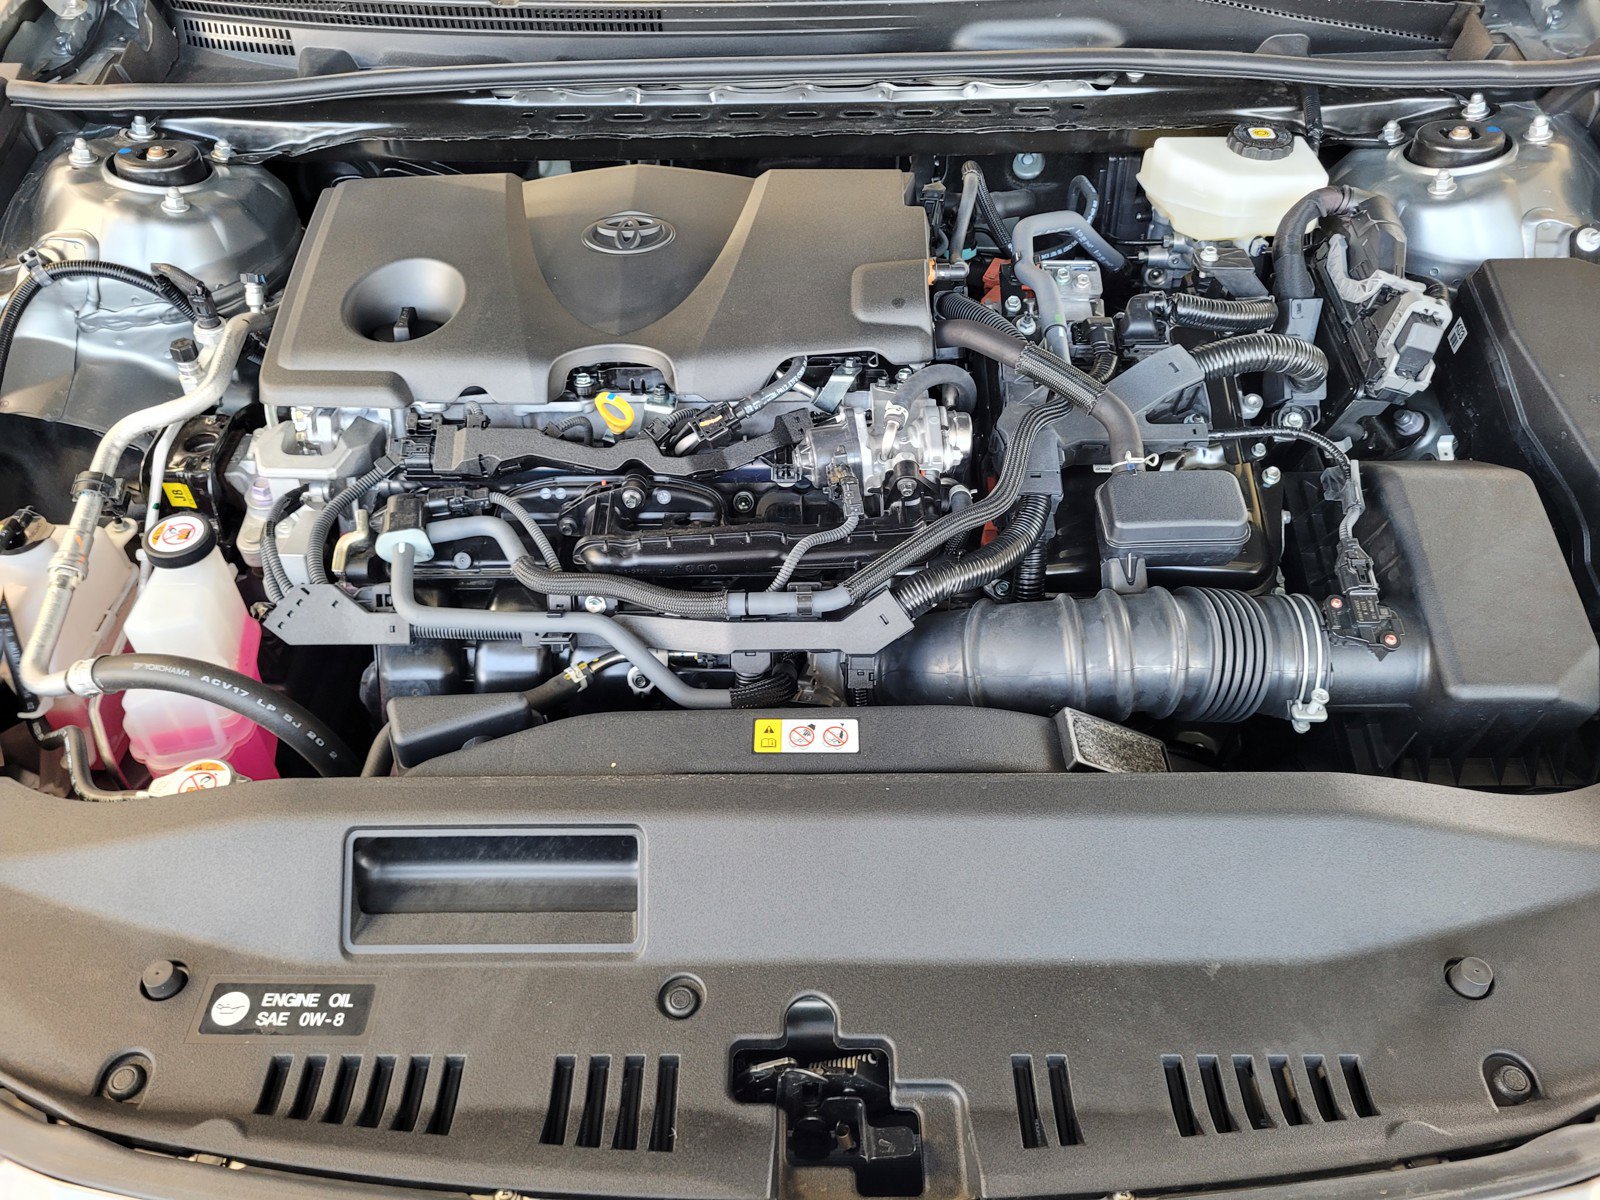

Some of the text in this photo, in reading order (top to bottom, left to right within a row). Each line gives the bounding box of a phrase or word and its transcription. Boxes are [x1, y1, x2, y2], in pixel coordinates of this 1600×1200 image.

[144, 663, 191, 677] YOKOHAMA
[200, 675, 250, 698] ACV17
[256, 698, 276, 712] LP
[261, 993, 354, 1008] ENGINE OIL
[255, 1012, 345, 1027] SAE 0W-8
